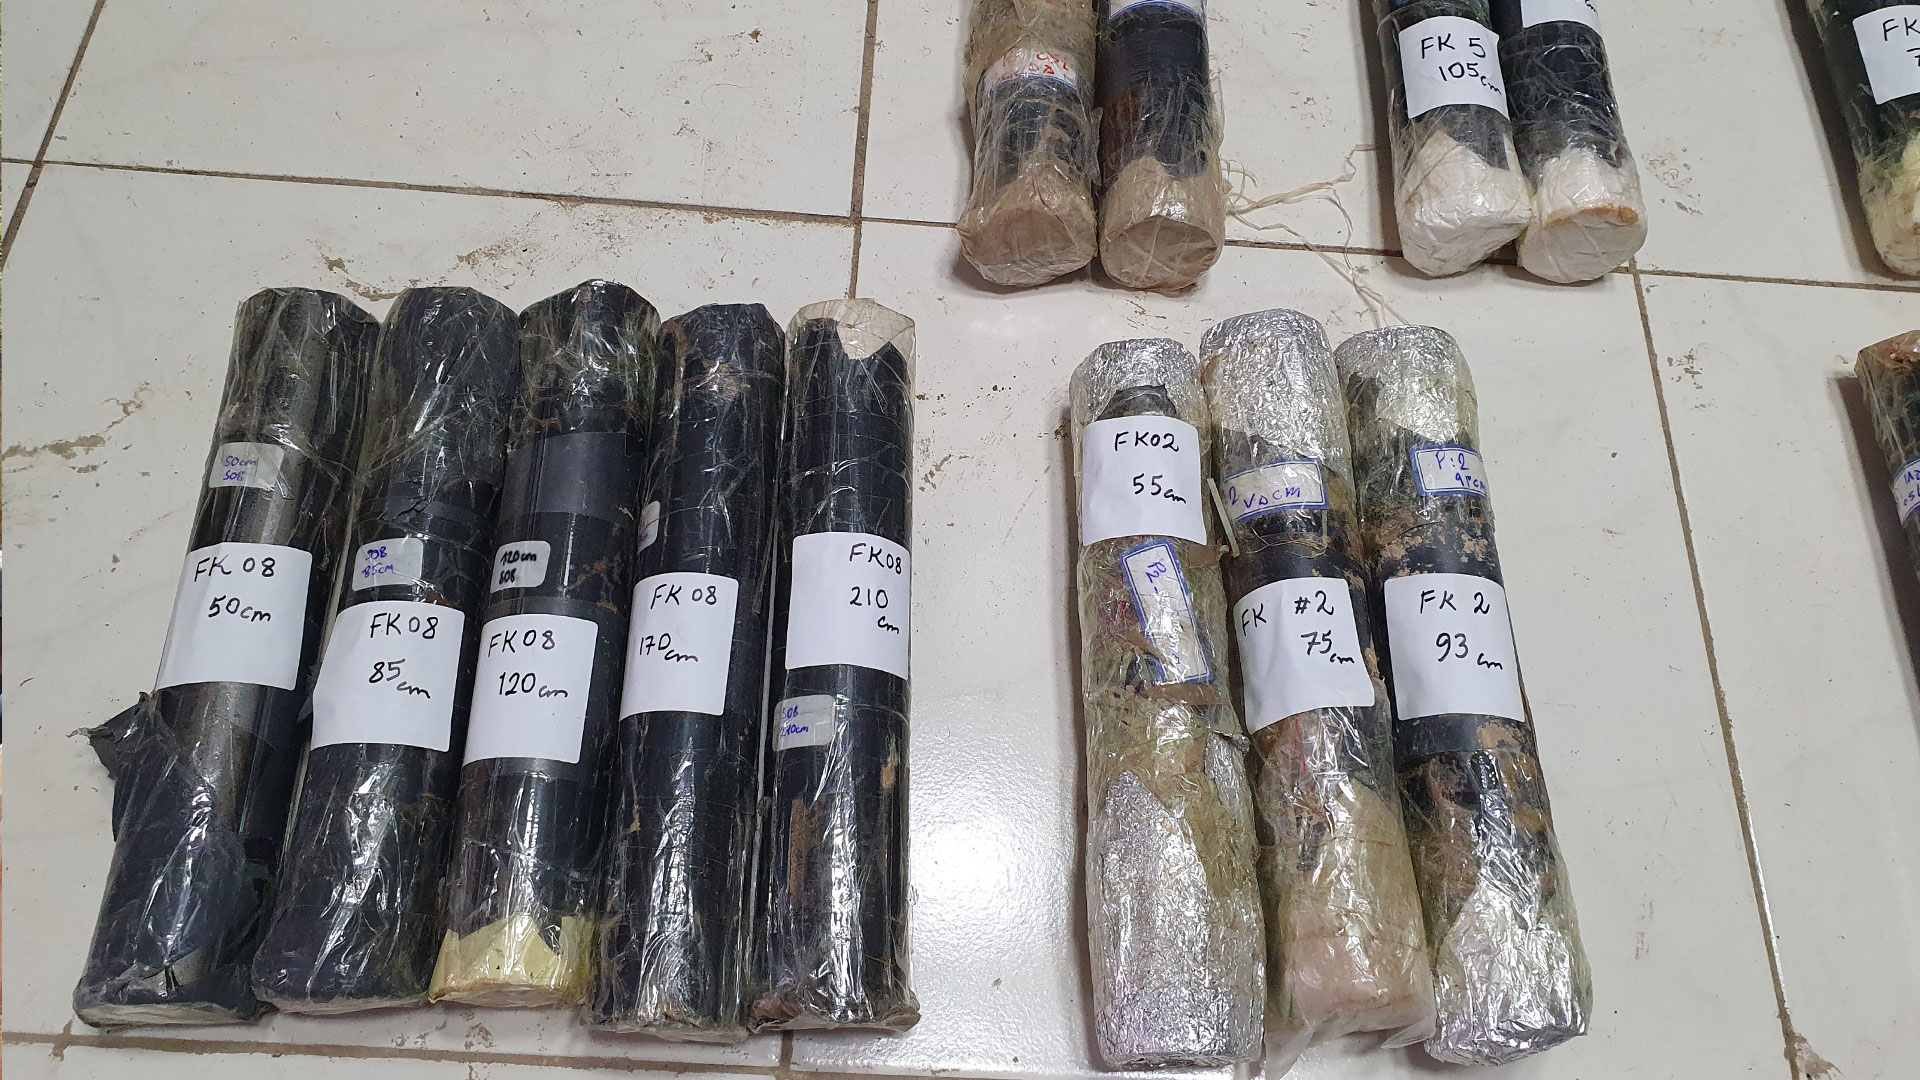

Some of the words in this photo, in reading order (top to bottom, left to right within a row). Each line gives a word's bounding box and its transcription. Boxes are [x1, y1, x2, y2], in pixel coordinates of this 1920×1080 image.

[1420, 33, 1456, 59] FK
[1468, 37, 1487, 58] 5
[849, 586, 889, 609] 210
[1419, 589, 1457, 614] FK
[1473, 591, 1491, 615] 2
[877, 615, 900, 635] cm
[1240, 603, 1268, 637] FK
